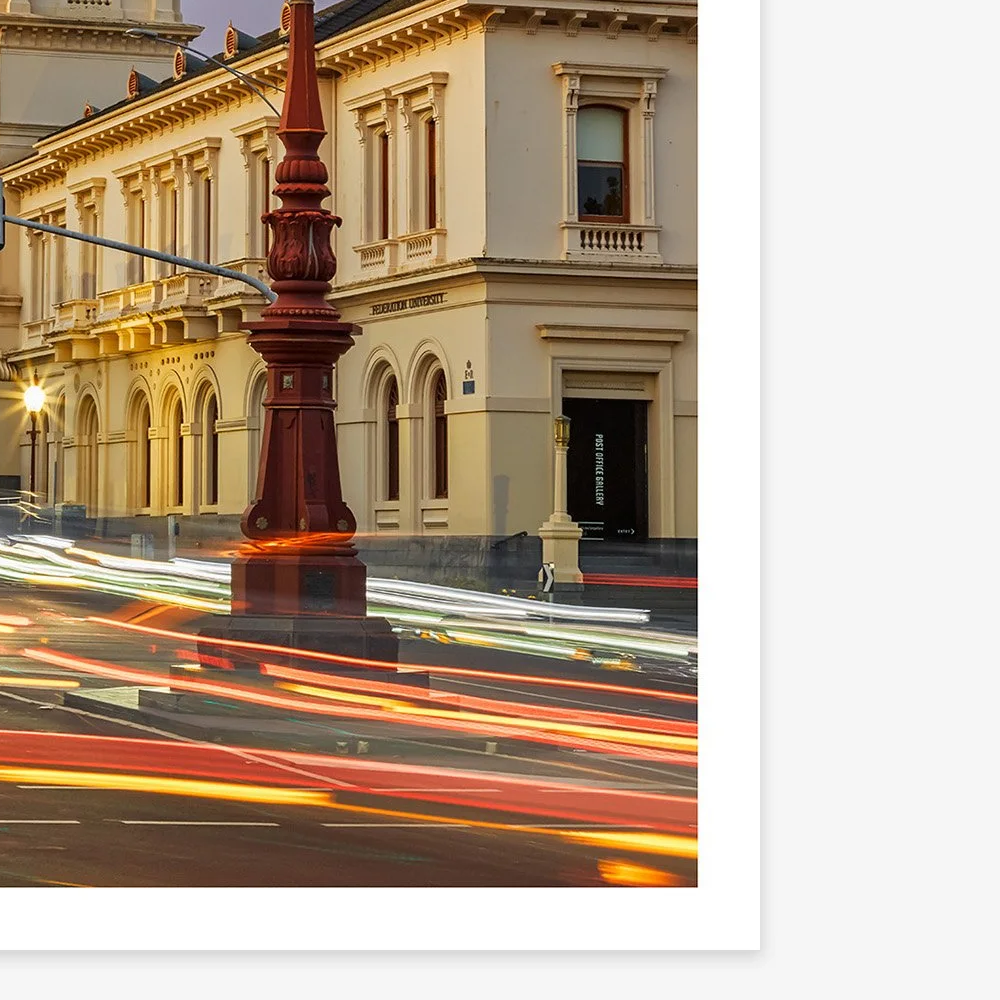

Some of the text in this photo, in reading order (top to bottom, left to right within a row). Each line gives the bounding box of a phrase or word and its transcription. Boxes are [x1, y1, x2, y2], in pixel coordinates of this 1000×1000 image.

[372, 293, 444, 316] FEDERATION UNIVERSITY
[595, 433, 605, 506] POST OFFICE GALLERY
